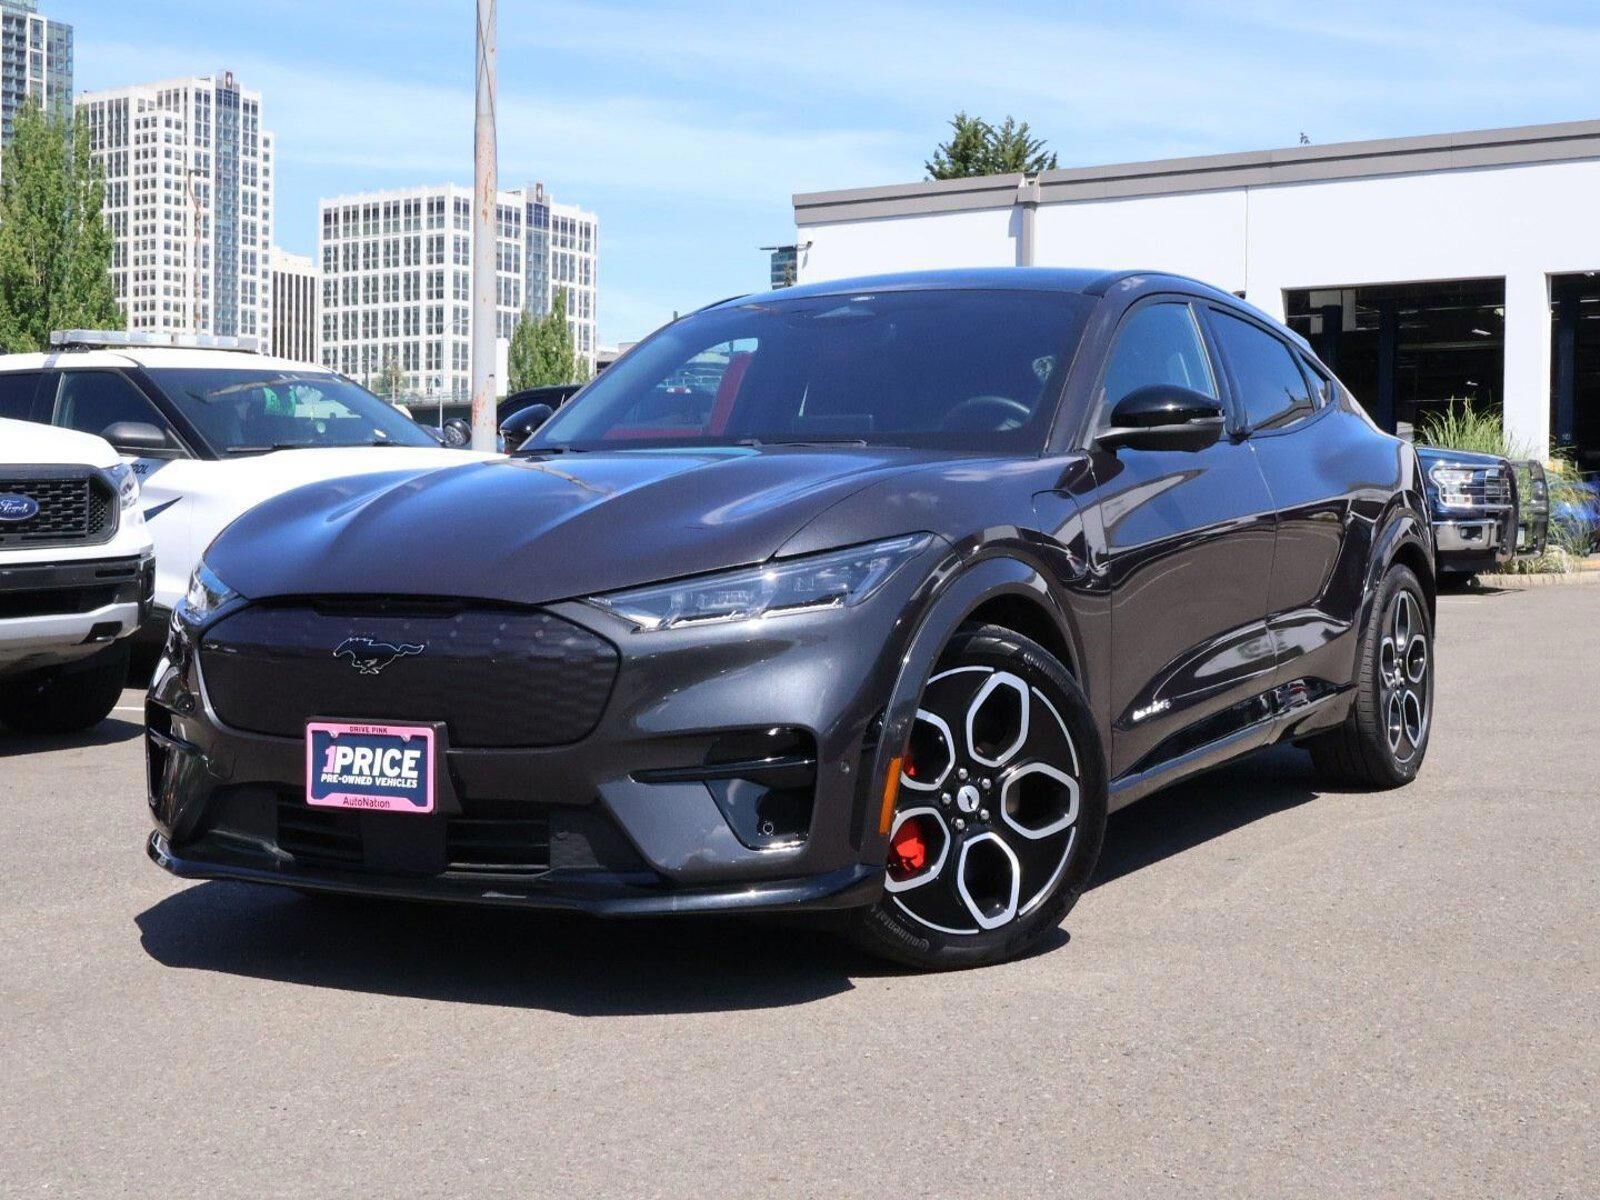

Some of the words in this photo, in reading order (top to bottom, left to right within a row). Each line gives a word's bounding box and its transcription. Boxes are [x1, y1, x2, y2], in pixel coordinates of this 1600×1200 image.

[0, 499, 28, 513] Ford
[320, 773, 373, 786] PRE-OWNED
[375, 776, 418, 789] VEHICLES
[342, 796, 390, 809] AutoNation
